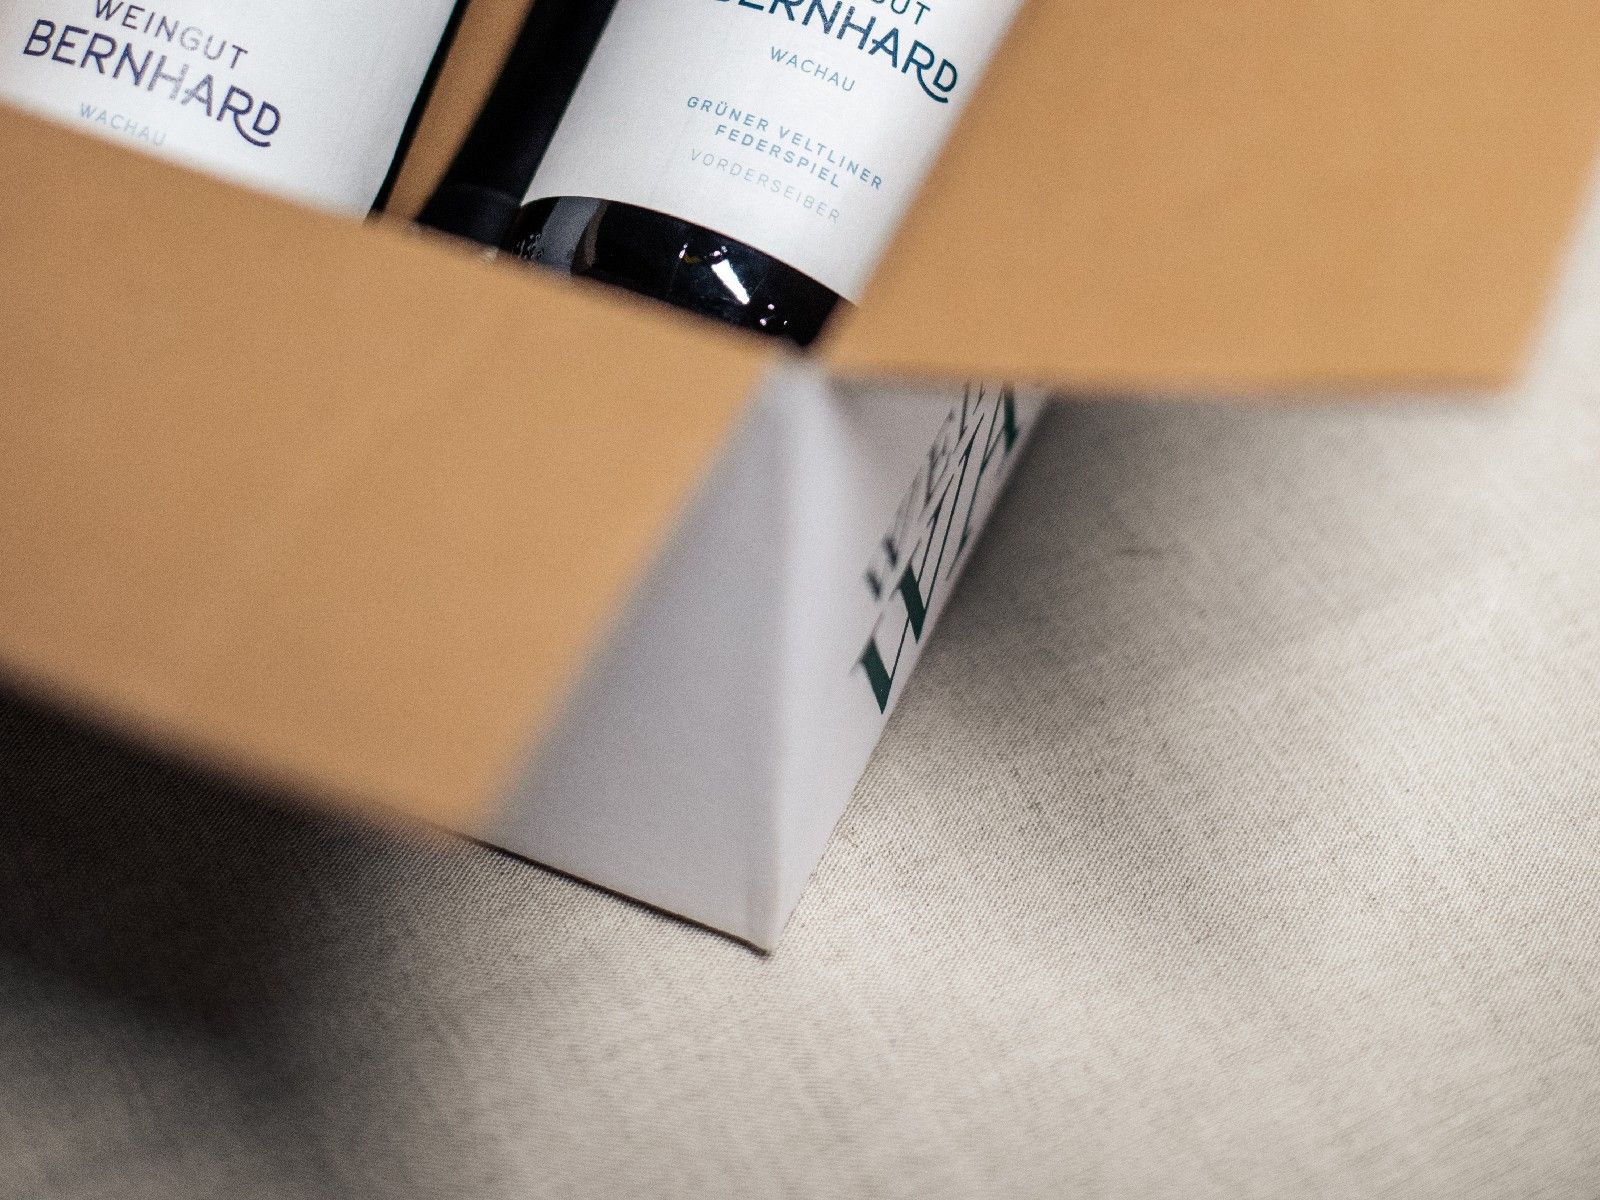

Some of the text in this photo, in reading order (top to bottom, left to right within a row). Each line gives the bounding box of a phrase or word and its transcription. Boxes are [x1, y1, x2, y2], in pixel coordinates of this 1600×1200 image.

[23, 19, 281, 148] BERNHARD
[770, 46, 856, 92] WACHAU
[79, 103, 168, 148] WACHAU
[686, 96, 884, 190] GRÜNER VELTLINER
[715, 124, 839, 188] FEDERSPIEL
[690, 148, 841, 225] VORDERSEIBER
